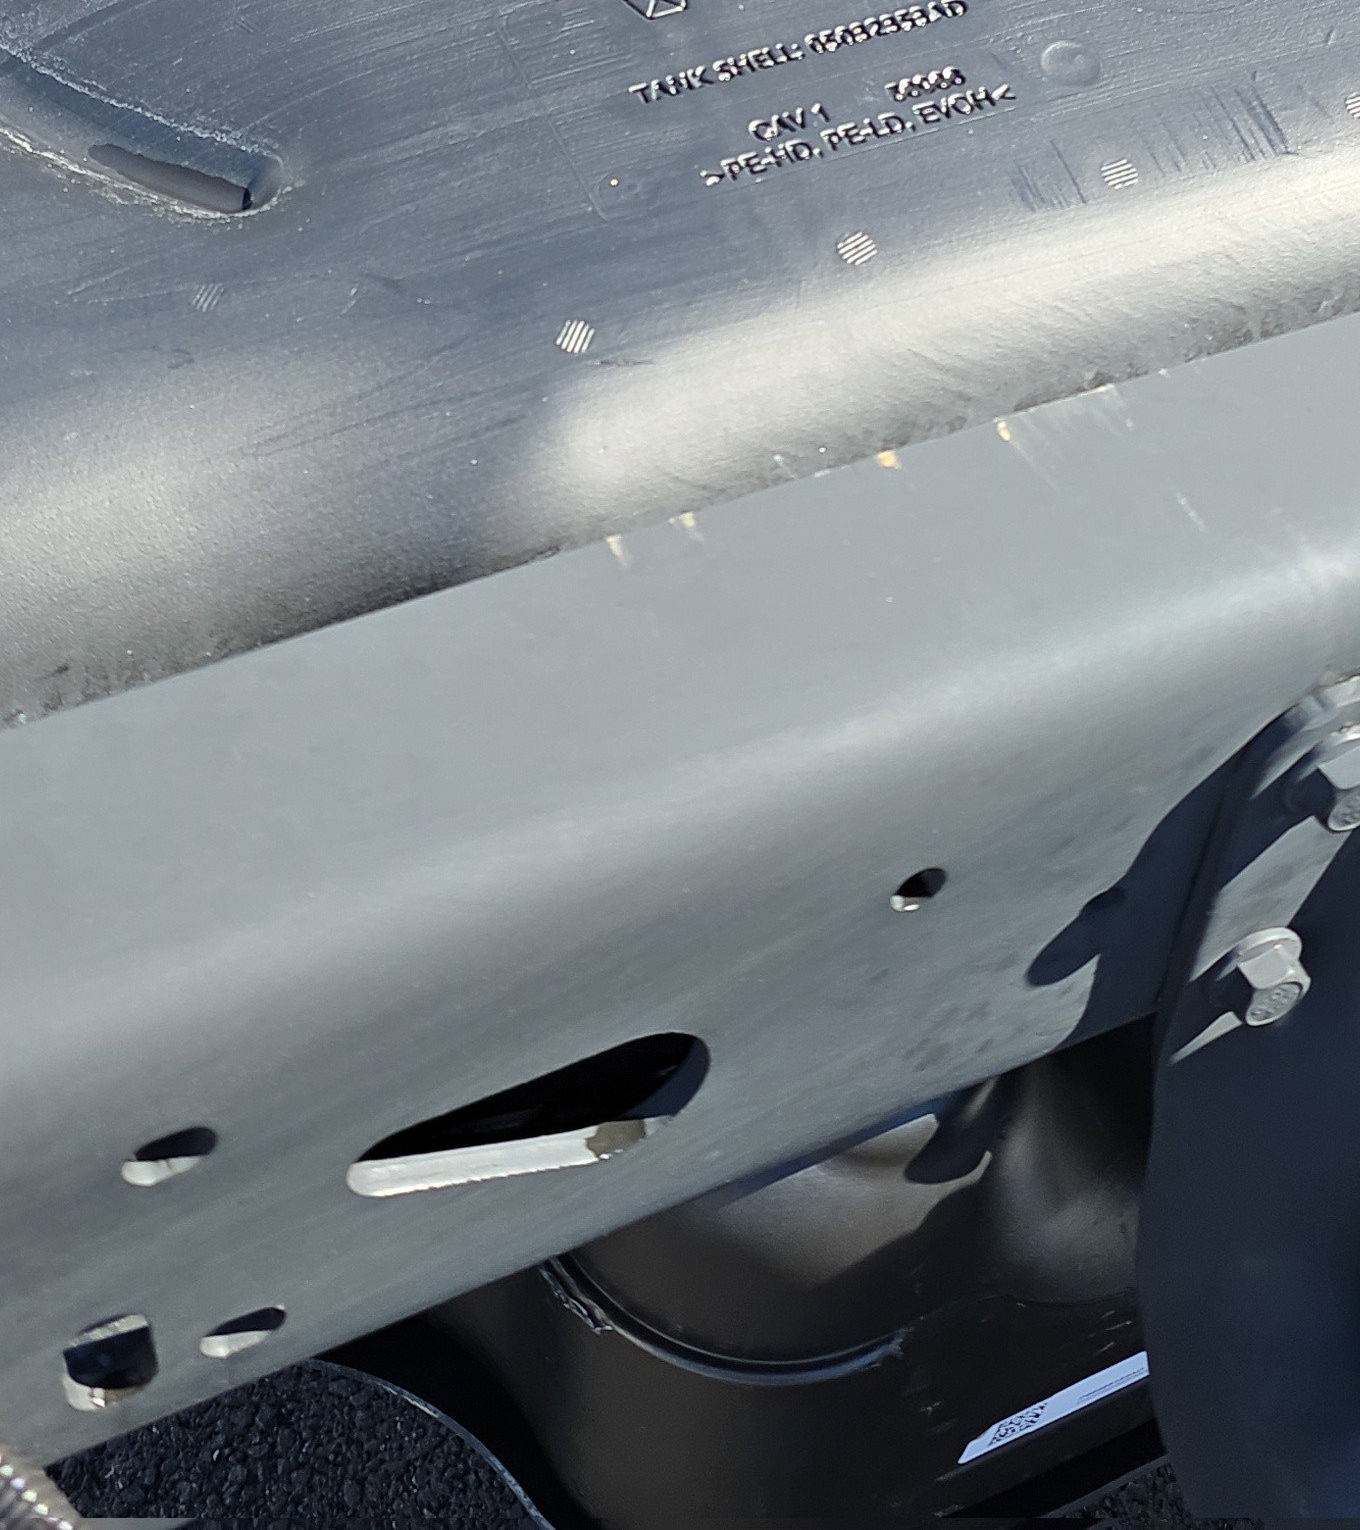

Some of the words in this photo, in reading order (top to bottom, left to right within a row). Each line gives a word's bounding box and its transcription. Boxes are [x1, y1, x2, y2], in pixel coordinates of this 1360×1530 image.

[628, 65, 715, 104] TANK
[748, 107, 806, 142] CAV
[810, 103, 831, 123] 1
